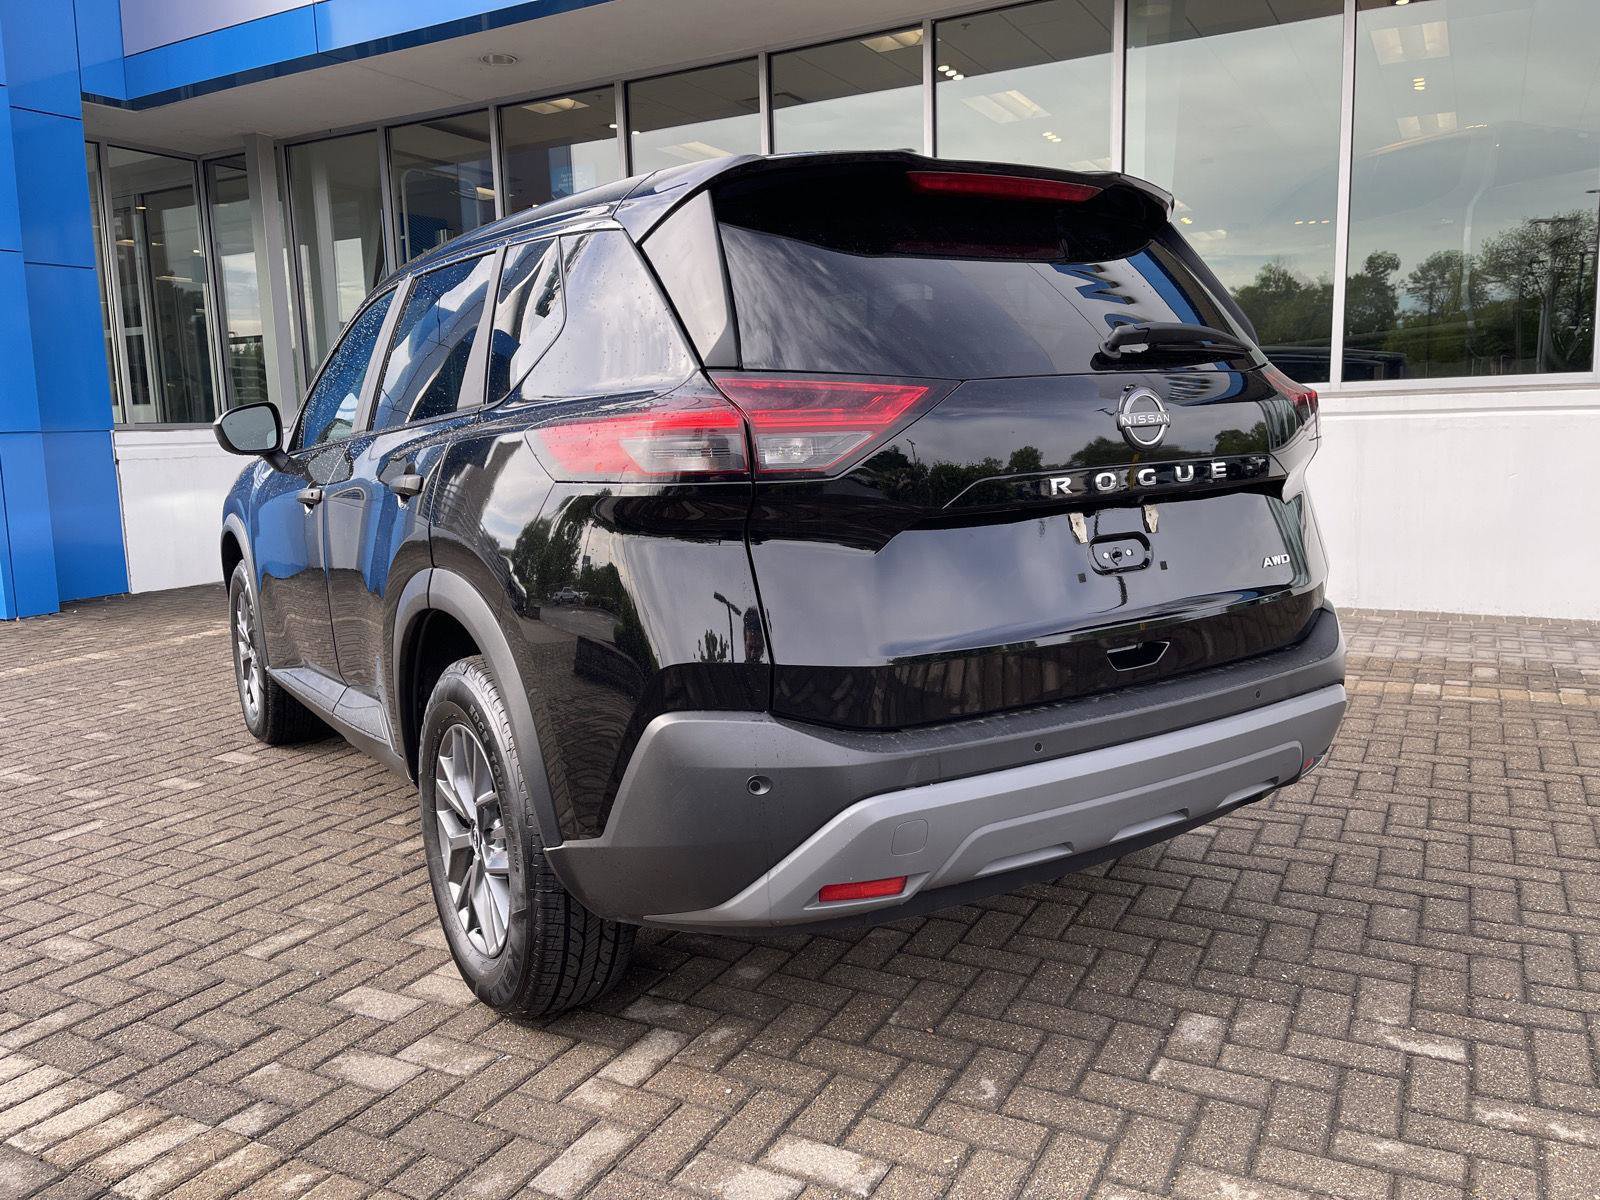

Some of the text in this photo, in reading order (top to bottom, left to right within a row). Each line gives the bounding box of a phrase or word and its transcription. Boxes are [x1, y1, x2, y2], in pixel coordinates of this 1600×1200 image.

[1121, 413, 1170, 426] NISSAN
[1050, 461, 1227, 496] ROGUE
[1262, 553, 1290, 569] AWD
